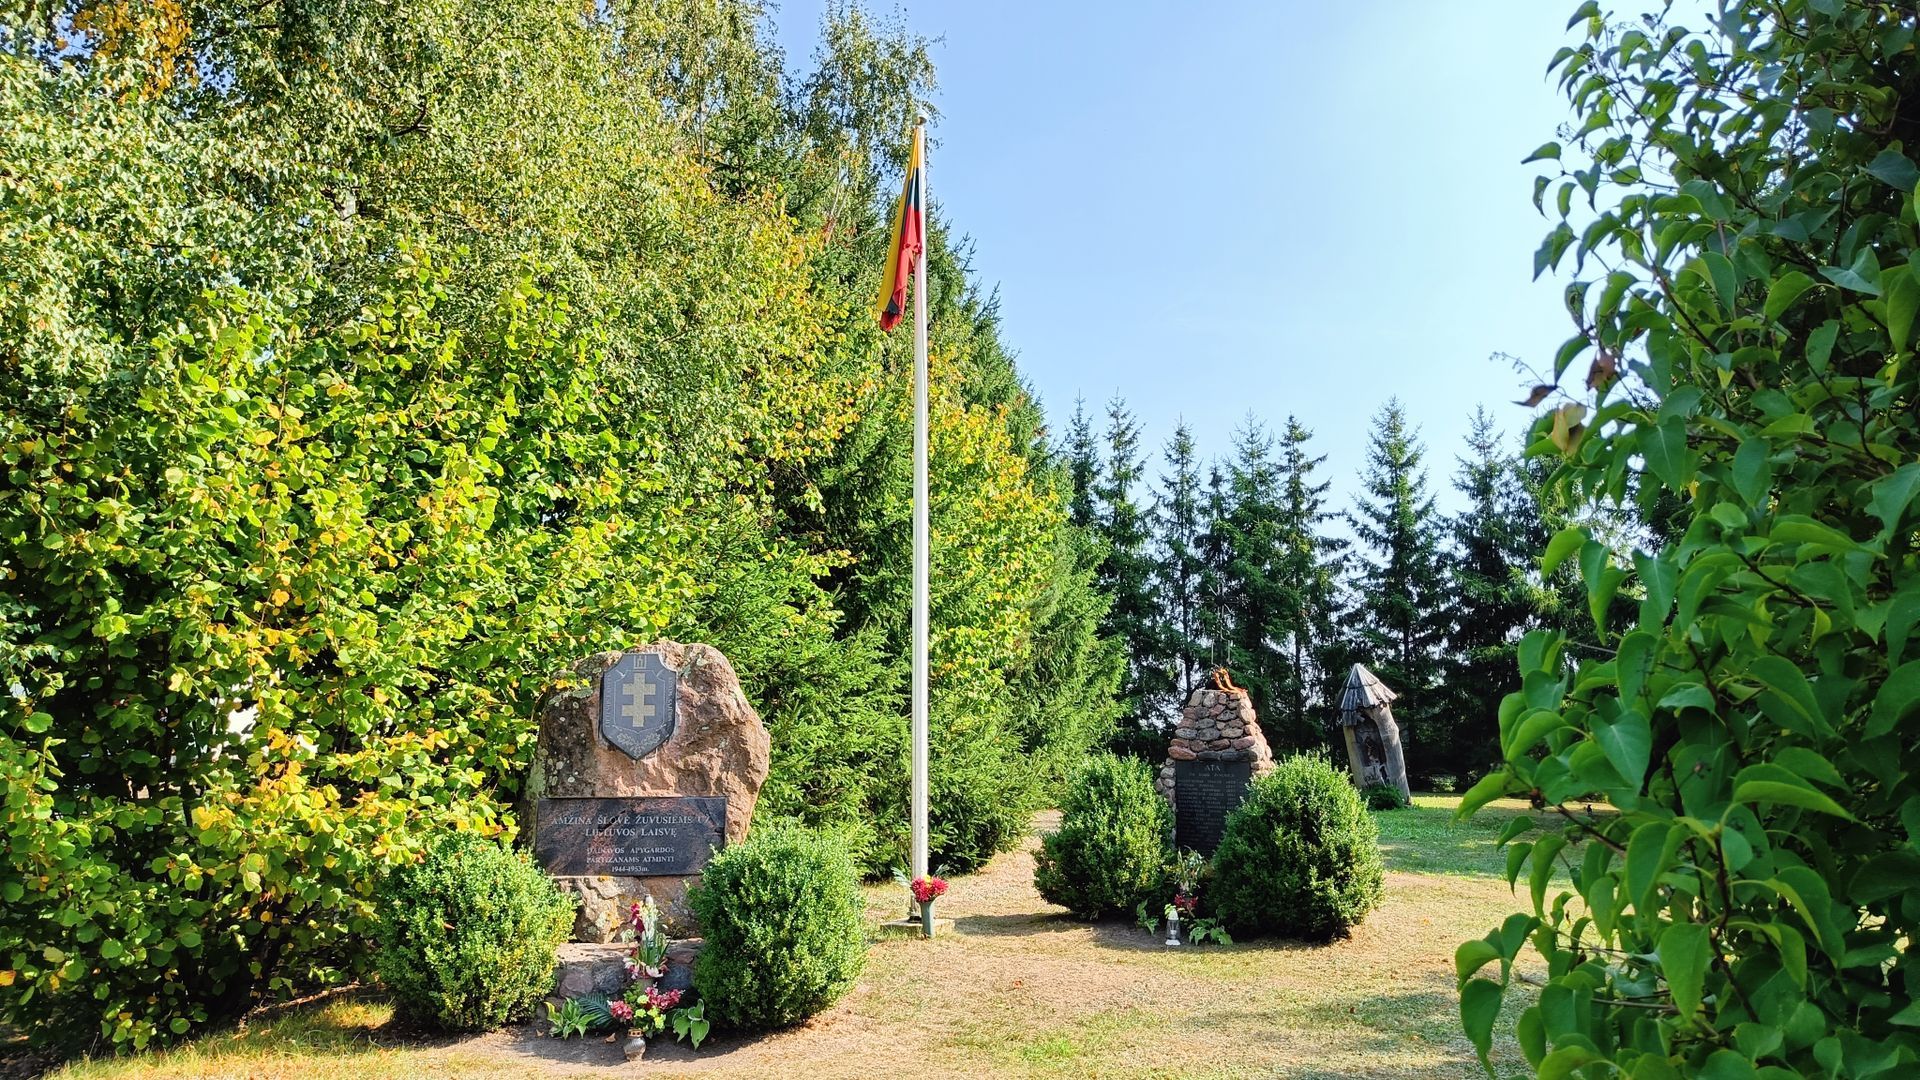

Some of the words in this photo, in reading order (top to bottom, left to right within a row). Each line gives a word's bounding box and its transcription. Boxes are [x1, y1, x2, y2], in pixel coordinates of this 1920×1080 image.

[635, 814, 693, 824] ŽUVUSIEMS
[641, 828, 677, 837] LAISVĘ
[630, 846, 675, 854] APYGARDOS
